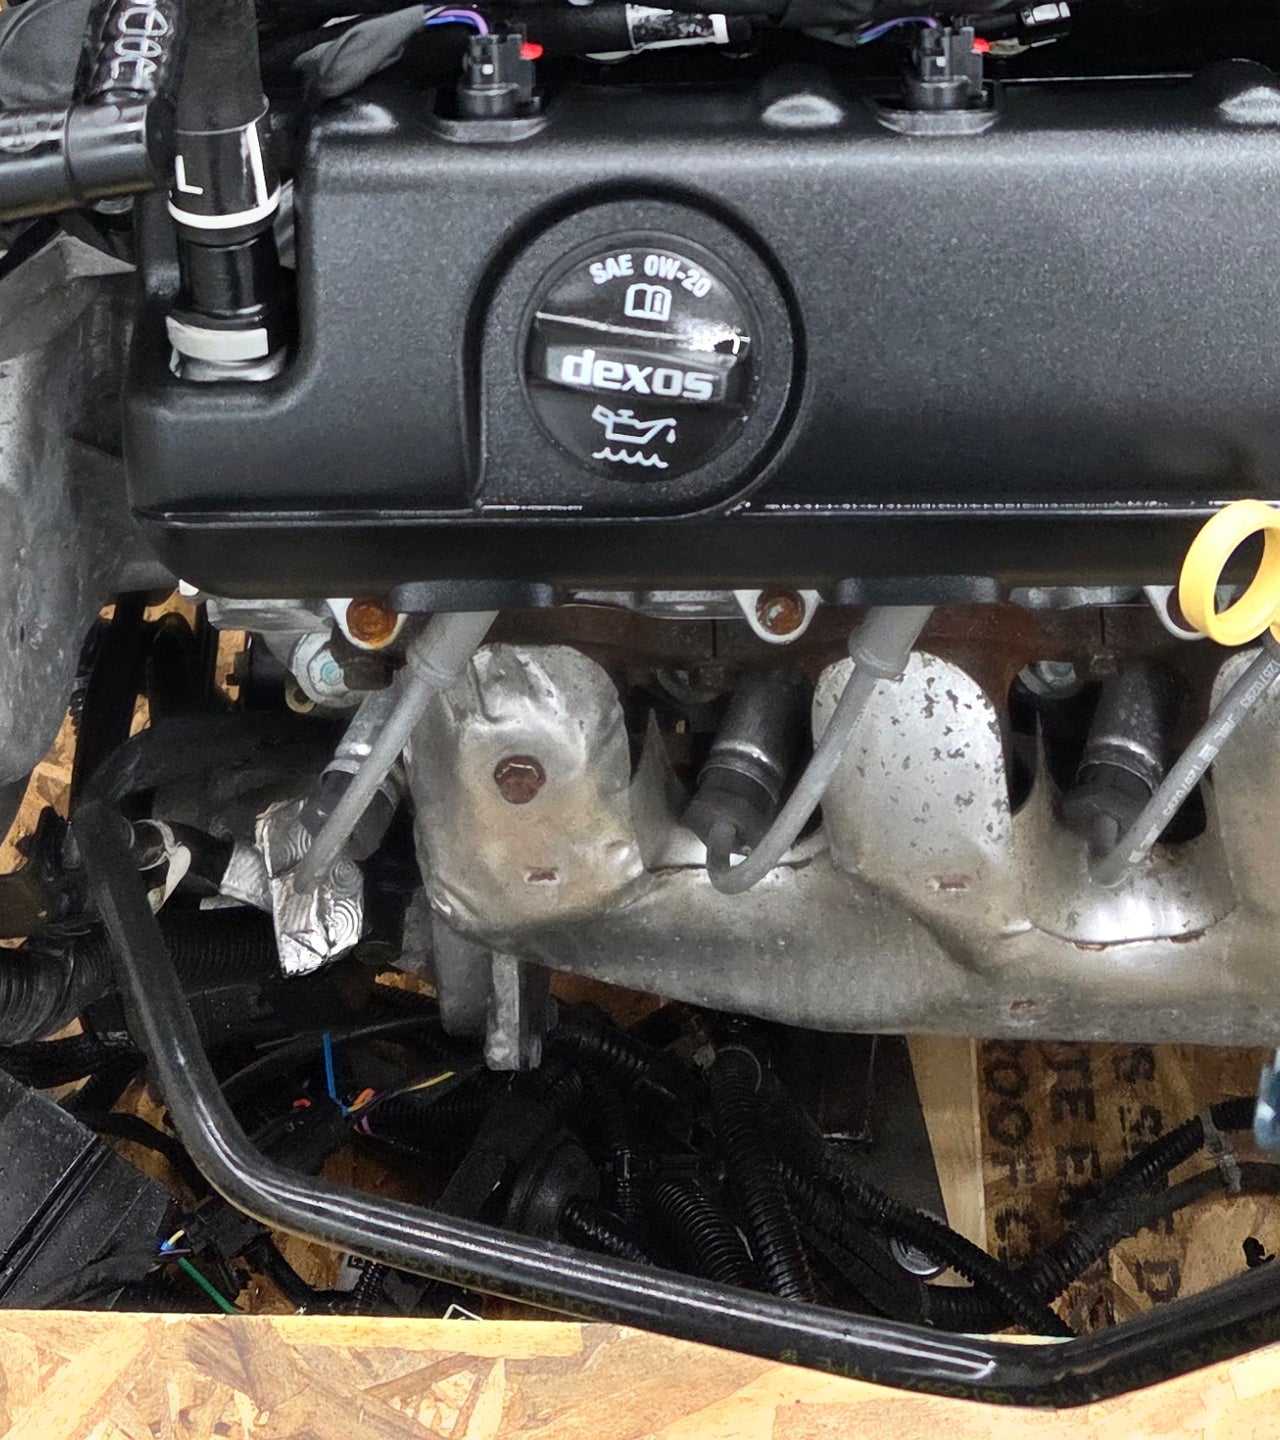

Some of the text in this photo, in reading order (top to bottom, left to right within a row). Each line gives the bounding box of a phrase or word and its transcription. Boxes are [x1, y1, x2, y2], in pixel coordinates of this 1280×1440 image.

[590, 254, 712, 298] SAE 0W-20
[561, 348, 715, 401] dexos
